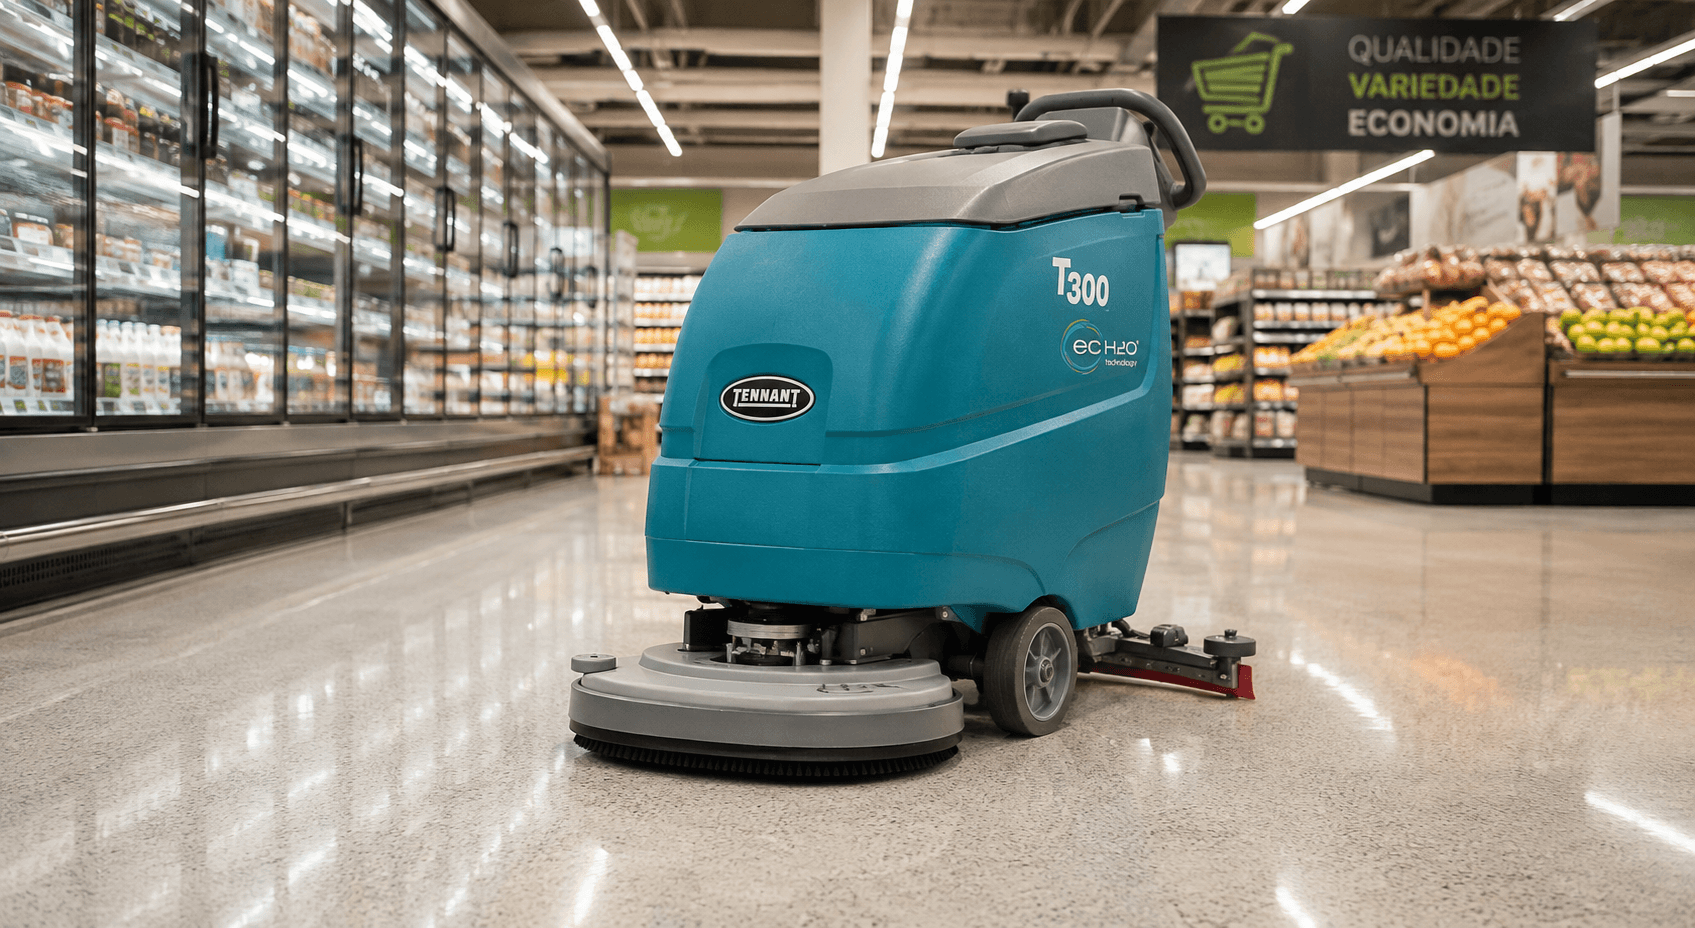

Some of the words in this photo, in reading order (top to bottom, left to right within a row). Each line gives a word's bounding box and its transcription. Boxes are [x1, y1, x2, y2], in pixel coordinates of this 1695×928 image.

[1348, 34, 1521, 66] QUALIDADE
[1348, 72, 1520, 100] VARIEDADE
[1348, 109, 1520, 137] ECONOMIA
[1052, 256, 1109, 307] T300
[733, 389, 800, 408] TENNANT
